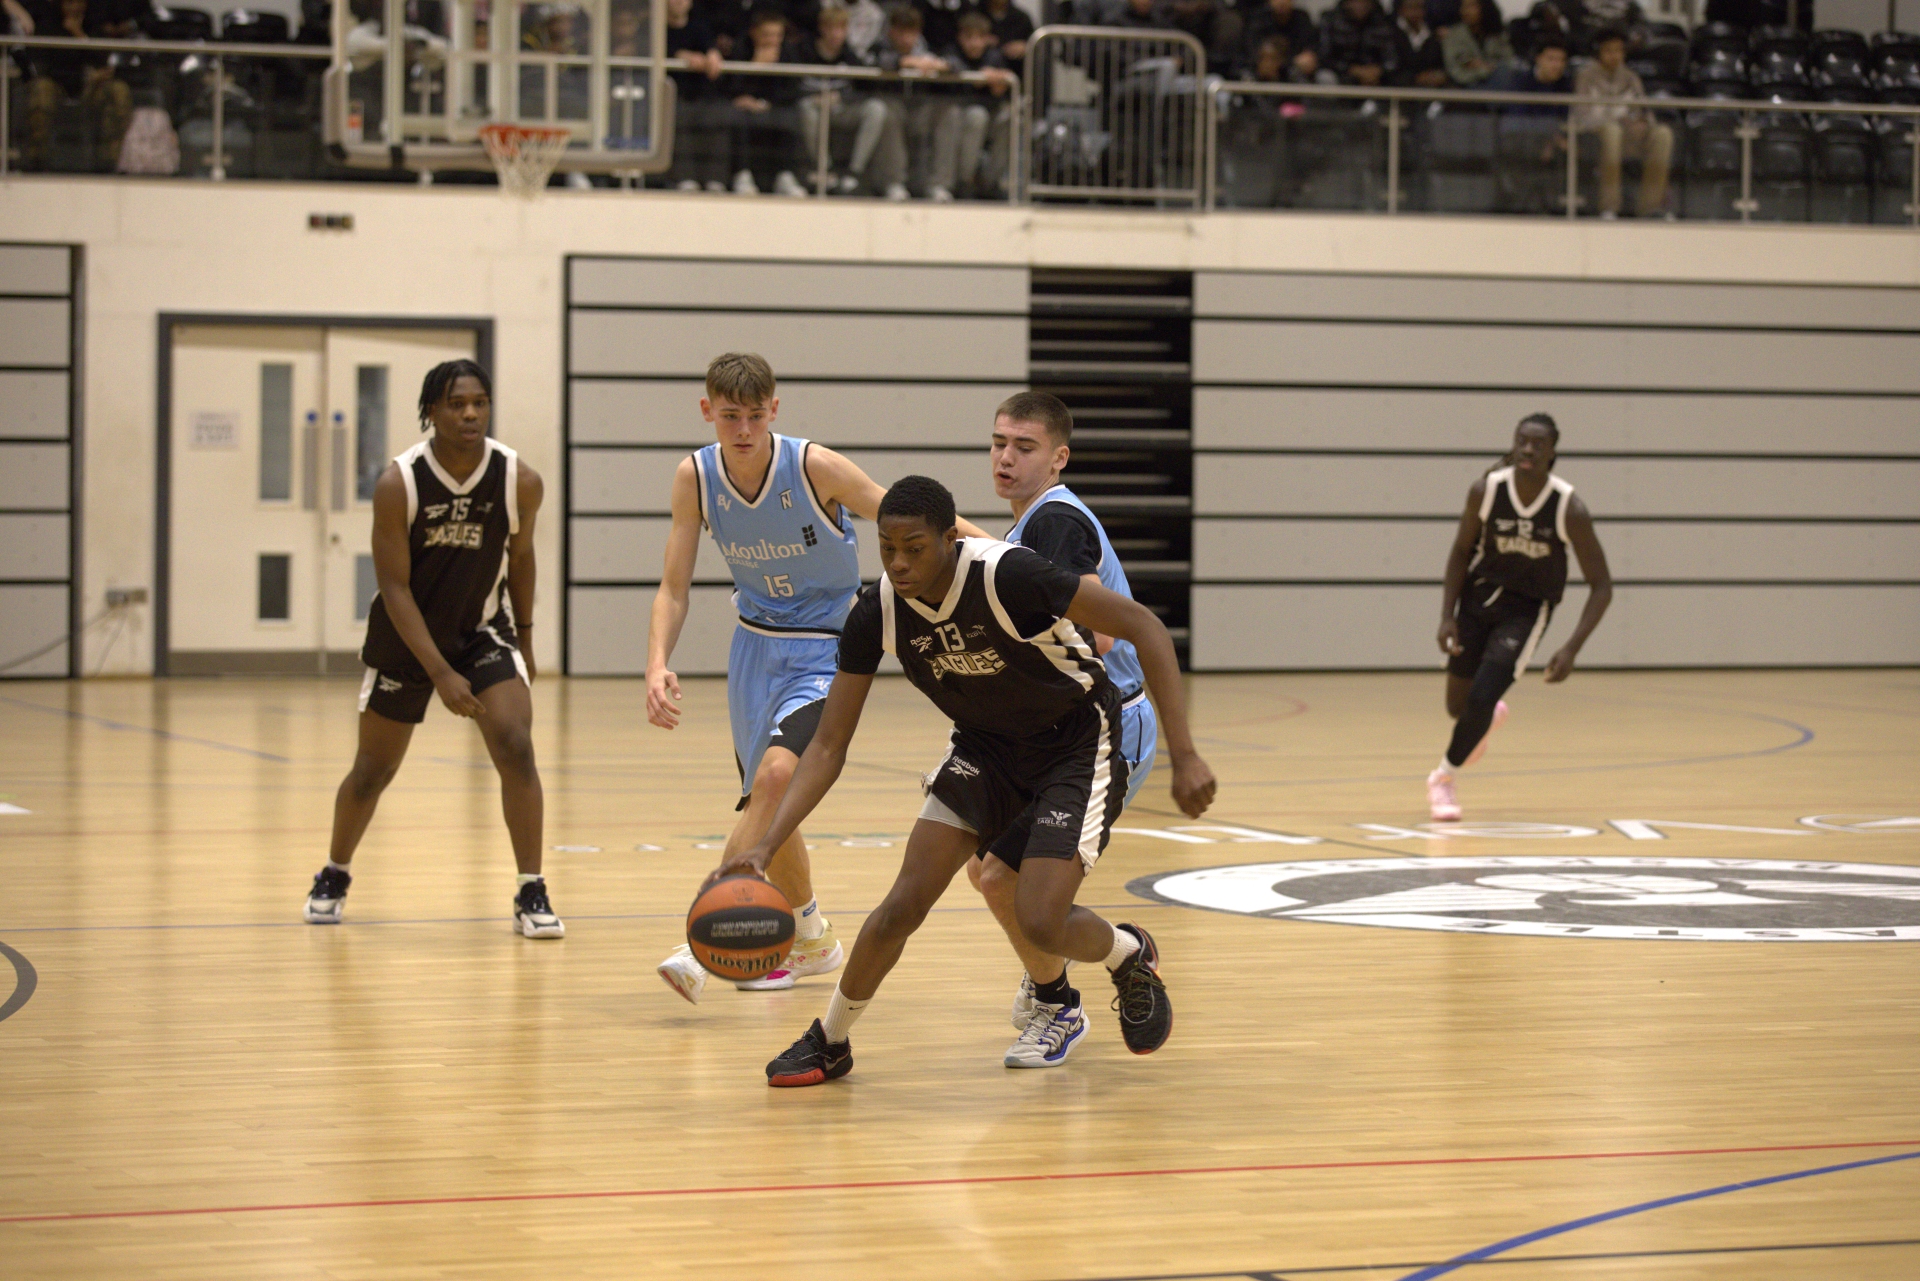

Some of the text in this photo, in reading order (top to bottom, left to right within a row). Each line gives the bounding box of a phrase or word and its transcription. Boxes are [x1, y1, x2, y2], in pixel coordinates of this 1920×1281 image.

[450, 497, 473, 521] 15
[721, 539, 808, 561] Moulton
[762, 574, 795, 598] 15
[934, 622, 966, 652] 13
[924, 647, 1008, 681] EAGLES
[951, 755, 981, 776] Reebok
[710, 951, 782, 974] Wilson
